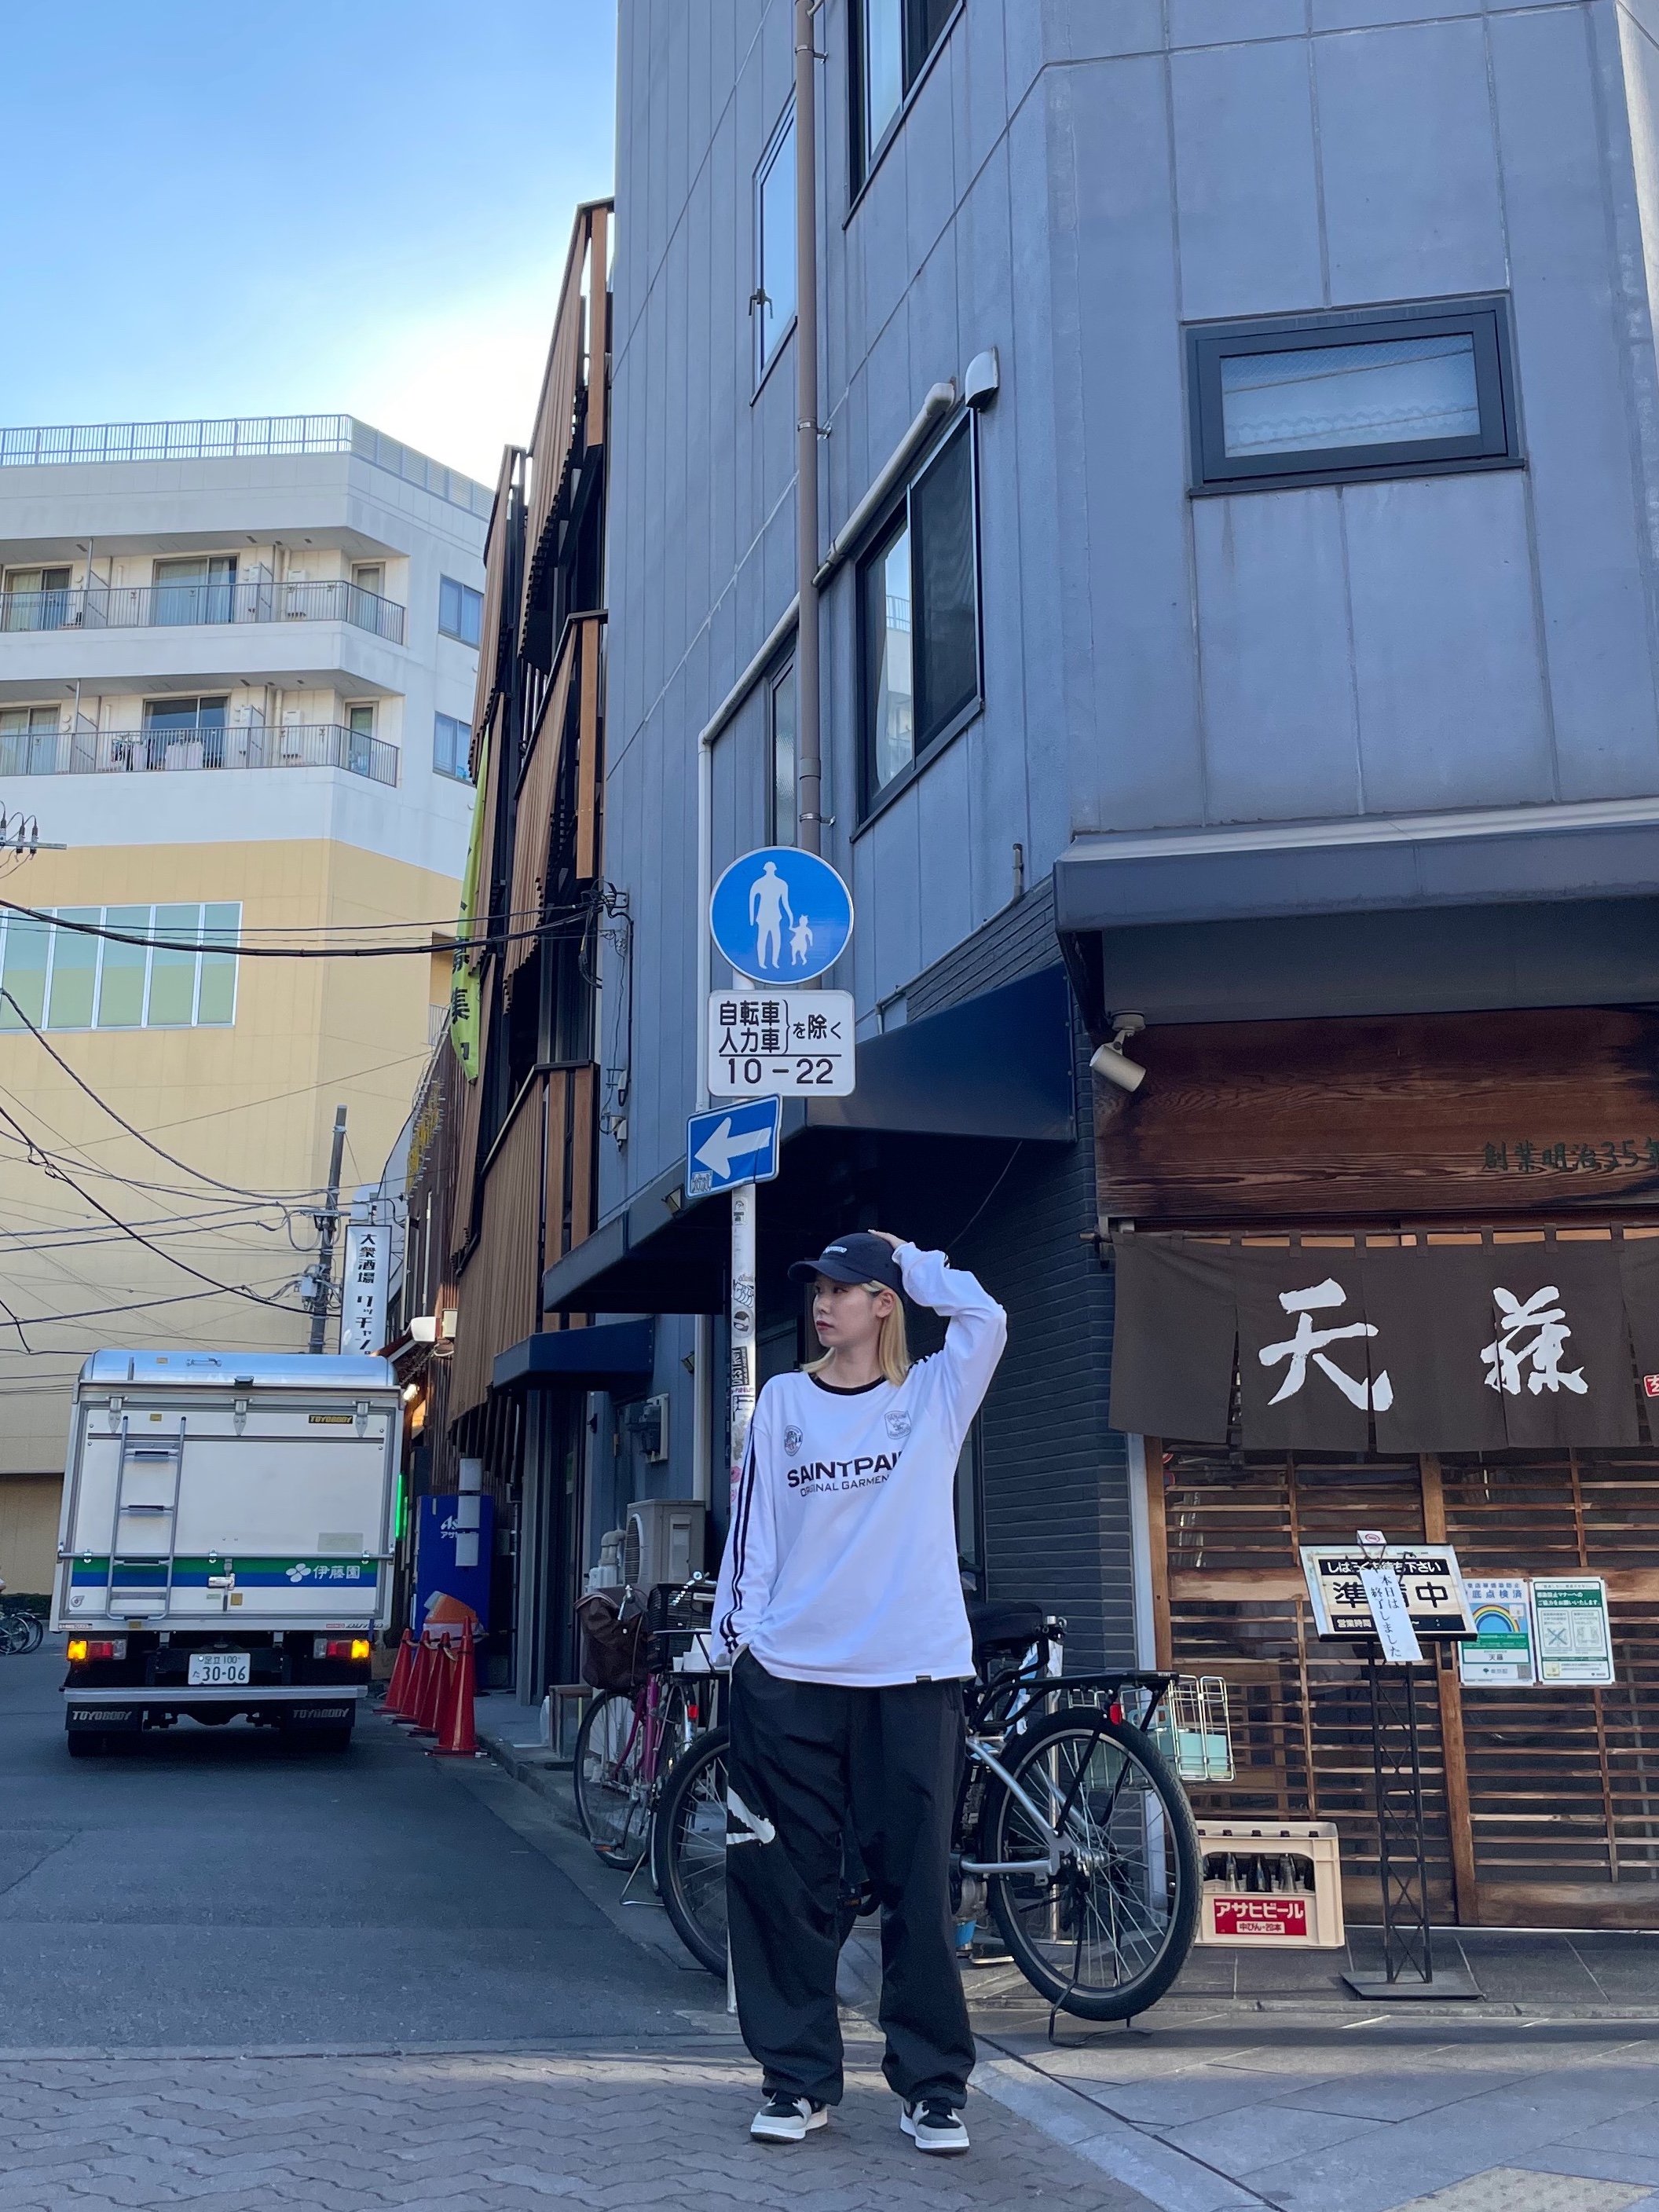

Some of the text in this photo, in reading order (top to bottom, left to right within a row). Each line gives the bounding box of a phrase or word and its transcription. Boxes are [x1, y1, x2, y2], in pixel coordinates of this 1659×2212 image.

[720, 1000, 781, 1026] 自転車
[793, 1013, 842, 1040] を除く
[719, 1027, 781, 1054] 人力車
[357, 1233, 377, 1284] 大衆酒場
[313, 1565, 361, 1579] 伊藤園
[1379, 1574, 1400, 1610] 本日は
[1466, 1589, 1522, 1599] 底点検済
[1370, 1586, 1403, 1658] 終了しました
[202, 1666, 247, 1681] 30-06
[72, 1710, 132, 1722] TOYOBODY
[1214, 1902, 1304, 1919] アサヒビール
